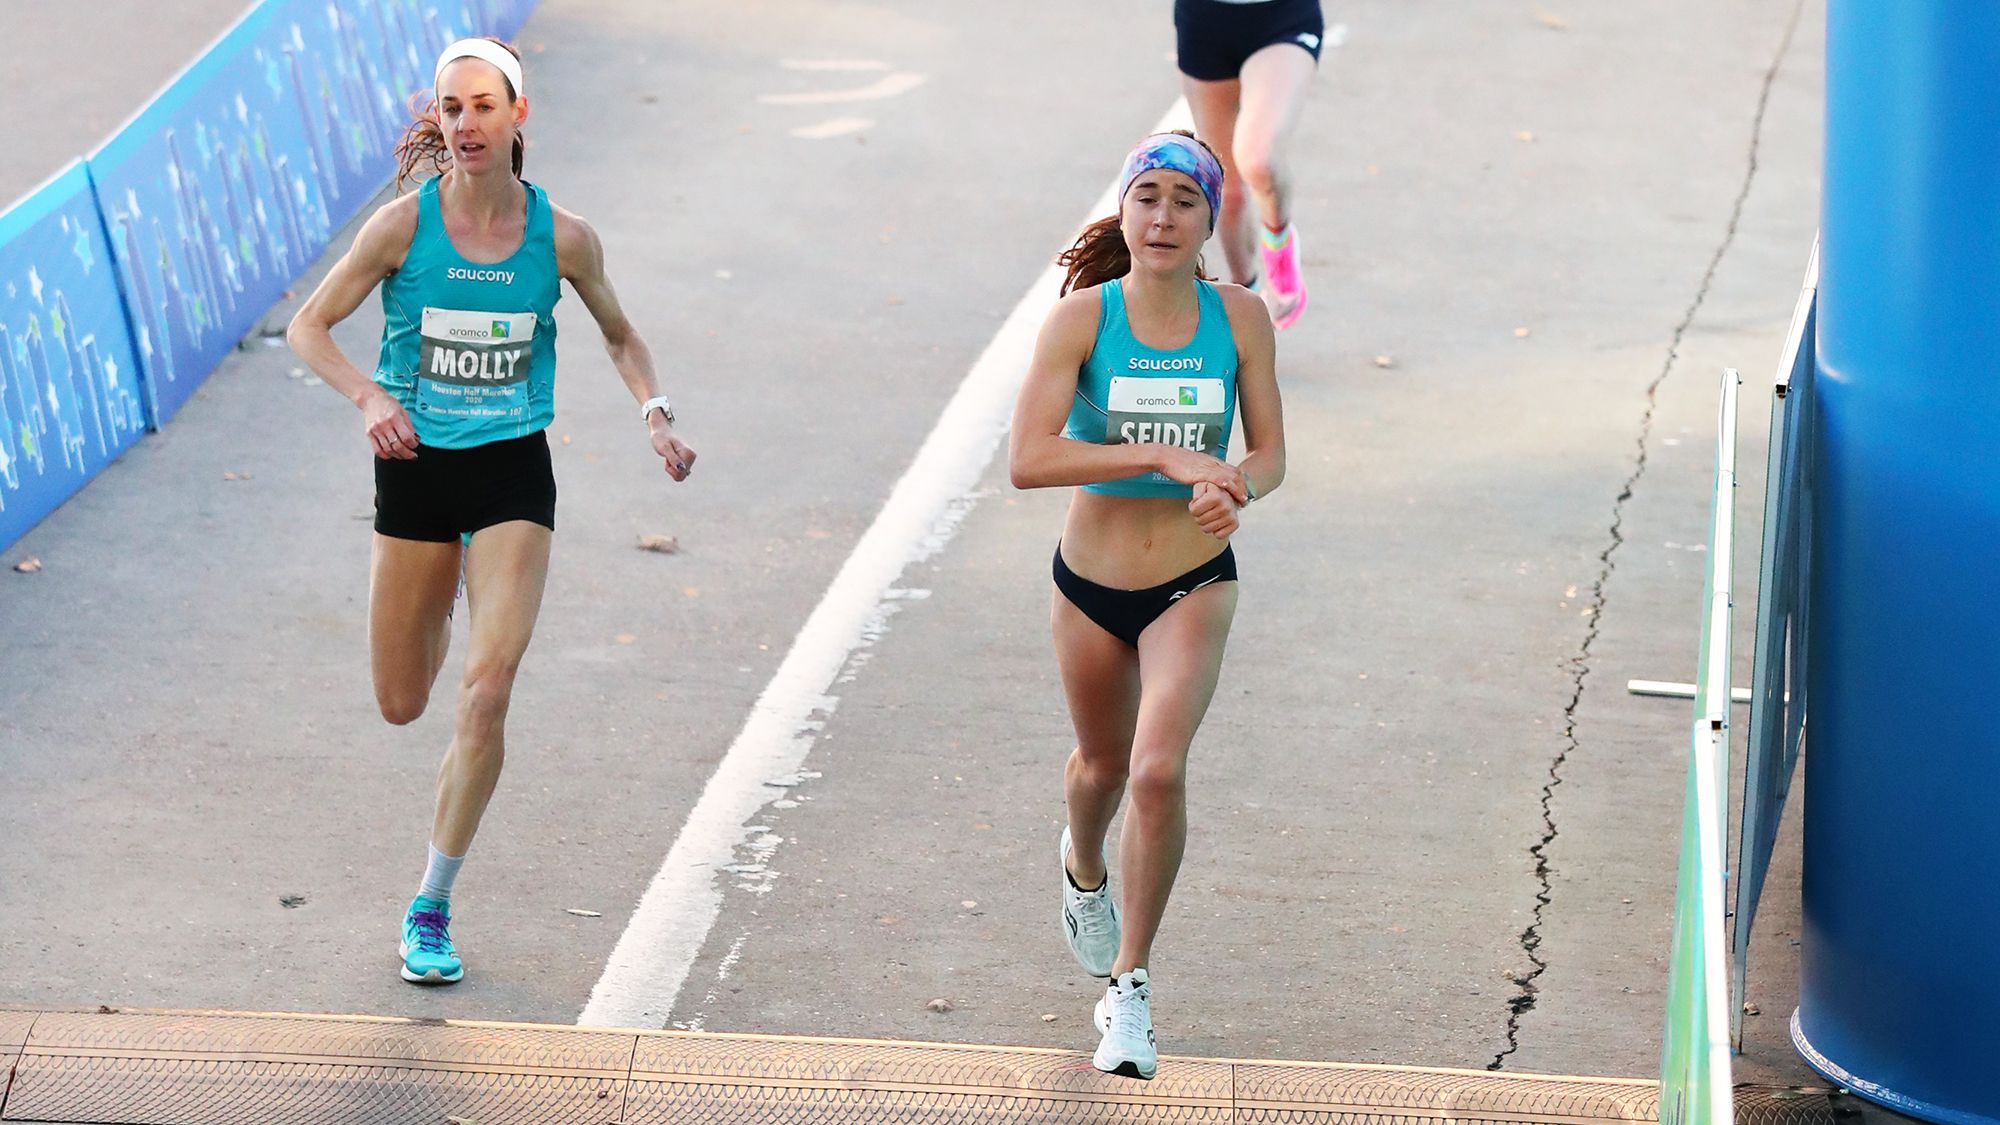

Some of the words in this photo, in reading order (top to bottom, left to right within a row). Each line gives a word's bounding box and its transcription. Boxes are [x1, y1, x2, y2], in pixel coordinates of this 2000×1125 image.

[447, 267, 515, 285] saucony
[449, 328, 488, 338] aramco
[431, 346, 521, 379] MOLLY
[1128, 357, 1203, 371] saucony
[431, 384, 462, 396] Houston
[463, 386, 480, 396] Half
[465, 396, 483, 404] 2020
[1136, 398, 1176, 406] aramco
[1120, 421, 1206, 452] SEIDEL
